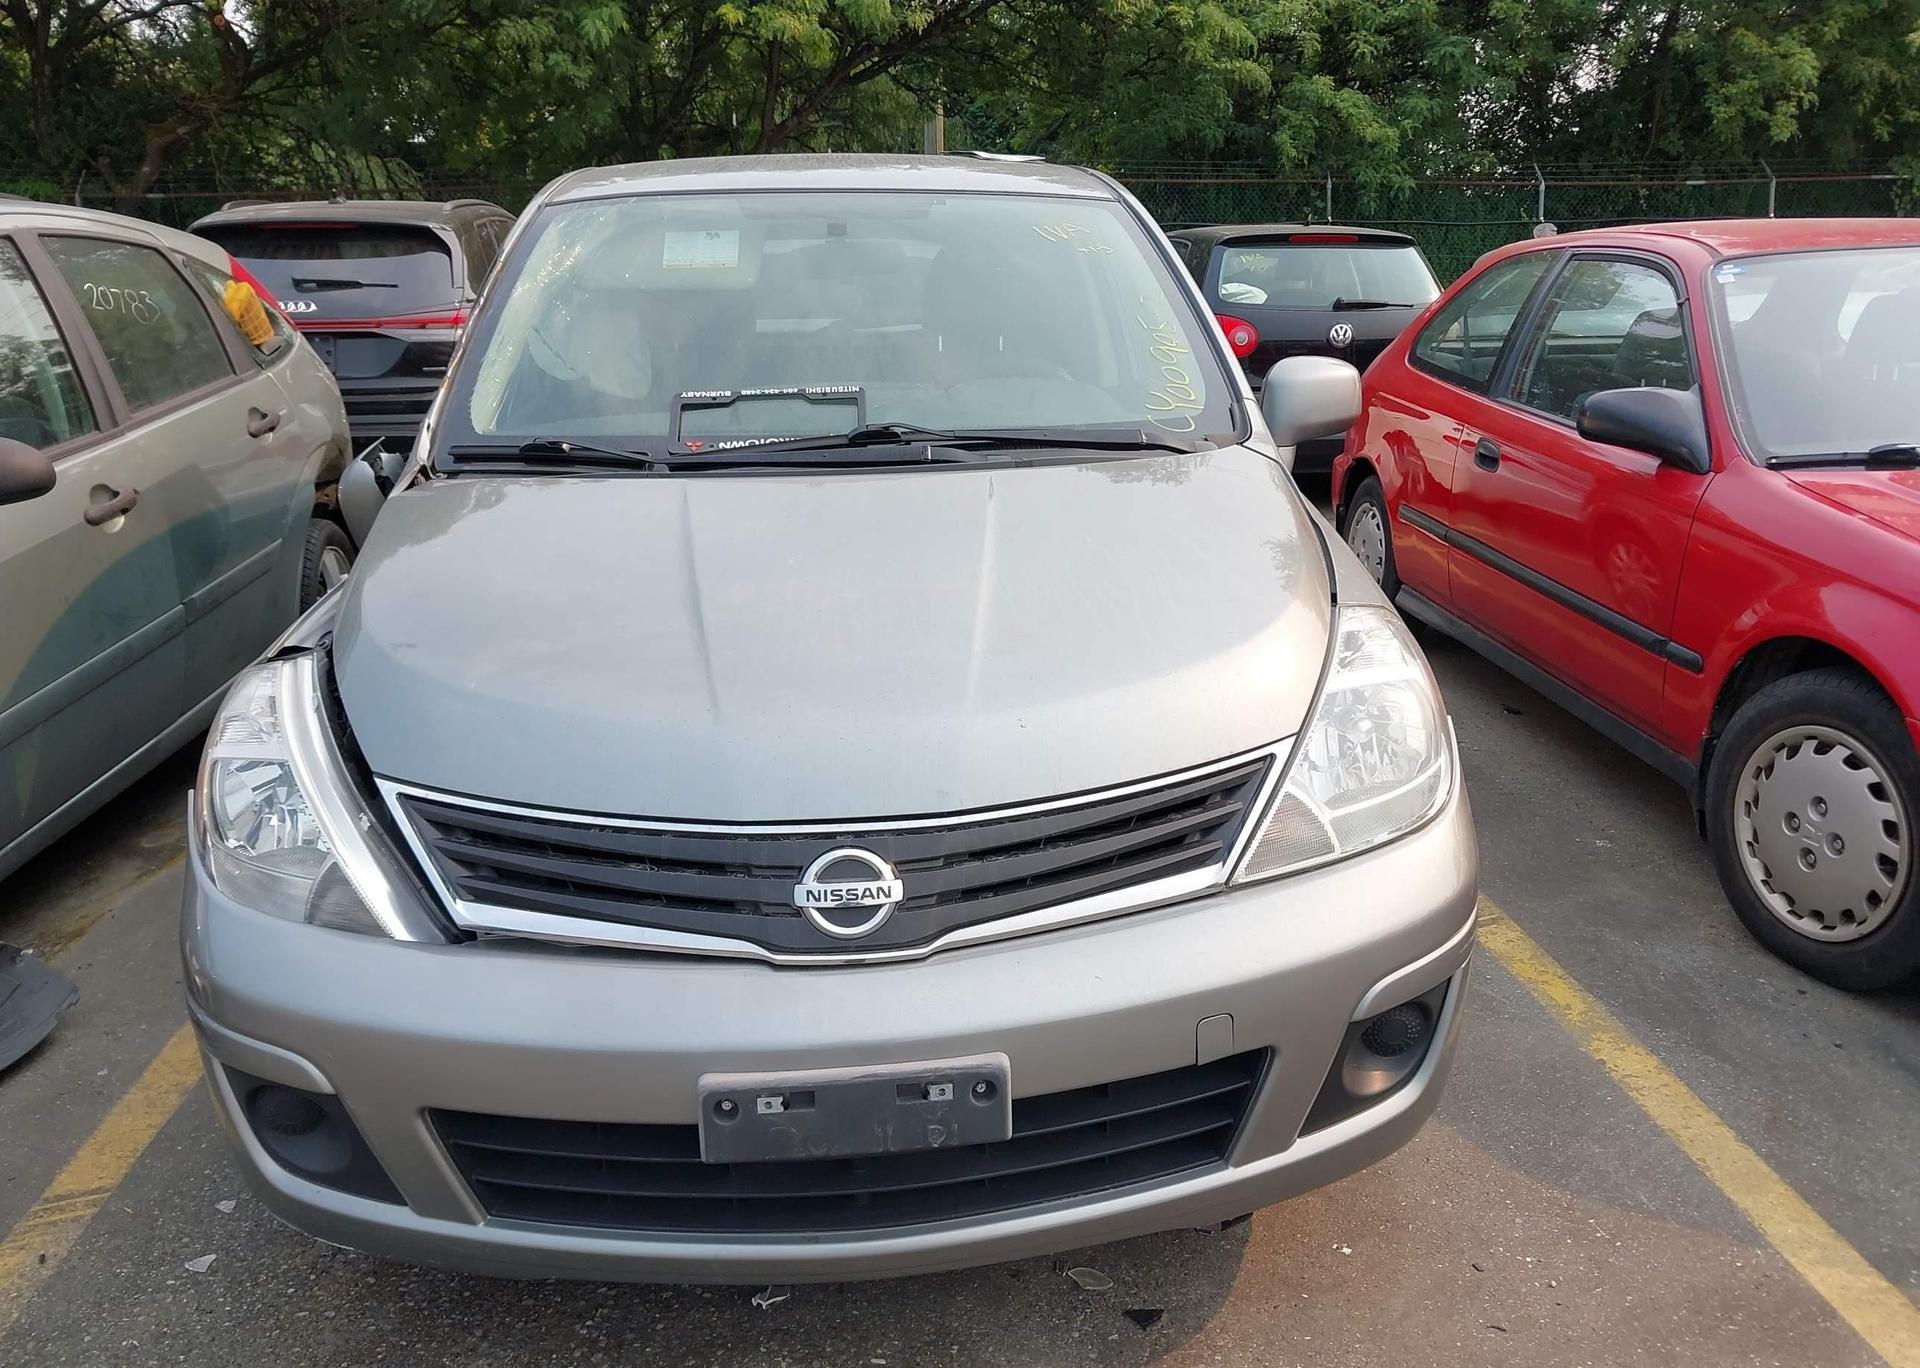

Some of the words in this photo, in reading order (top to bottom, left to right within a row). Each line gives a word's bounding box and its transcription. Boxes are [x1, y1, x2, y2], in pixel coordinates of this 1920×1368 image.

[83, 282, 161, 325] 20783
[680, 390, 732, 399] BURNABY
[805, 386, 860, 395] MITSUBISHI
[805, 885, 892, 903] NISSAN
